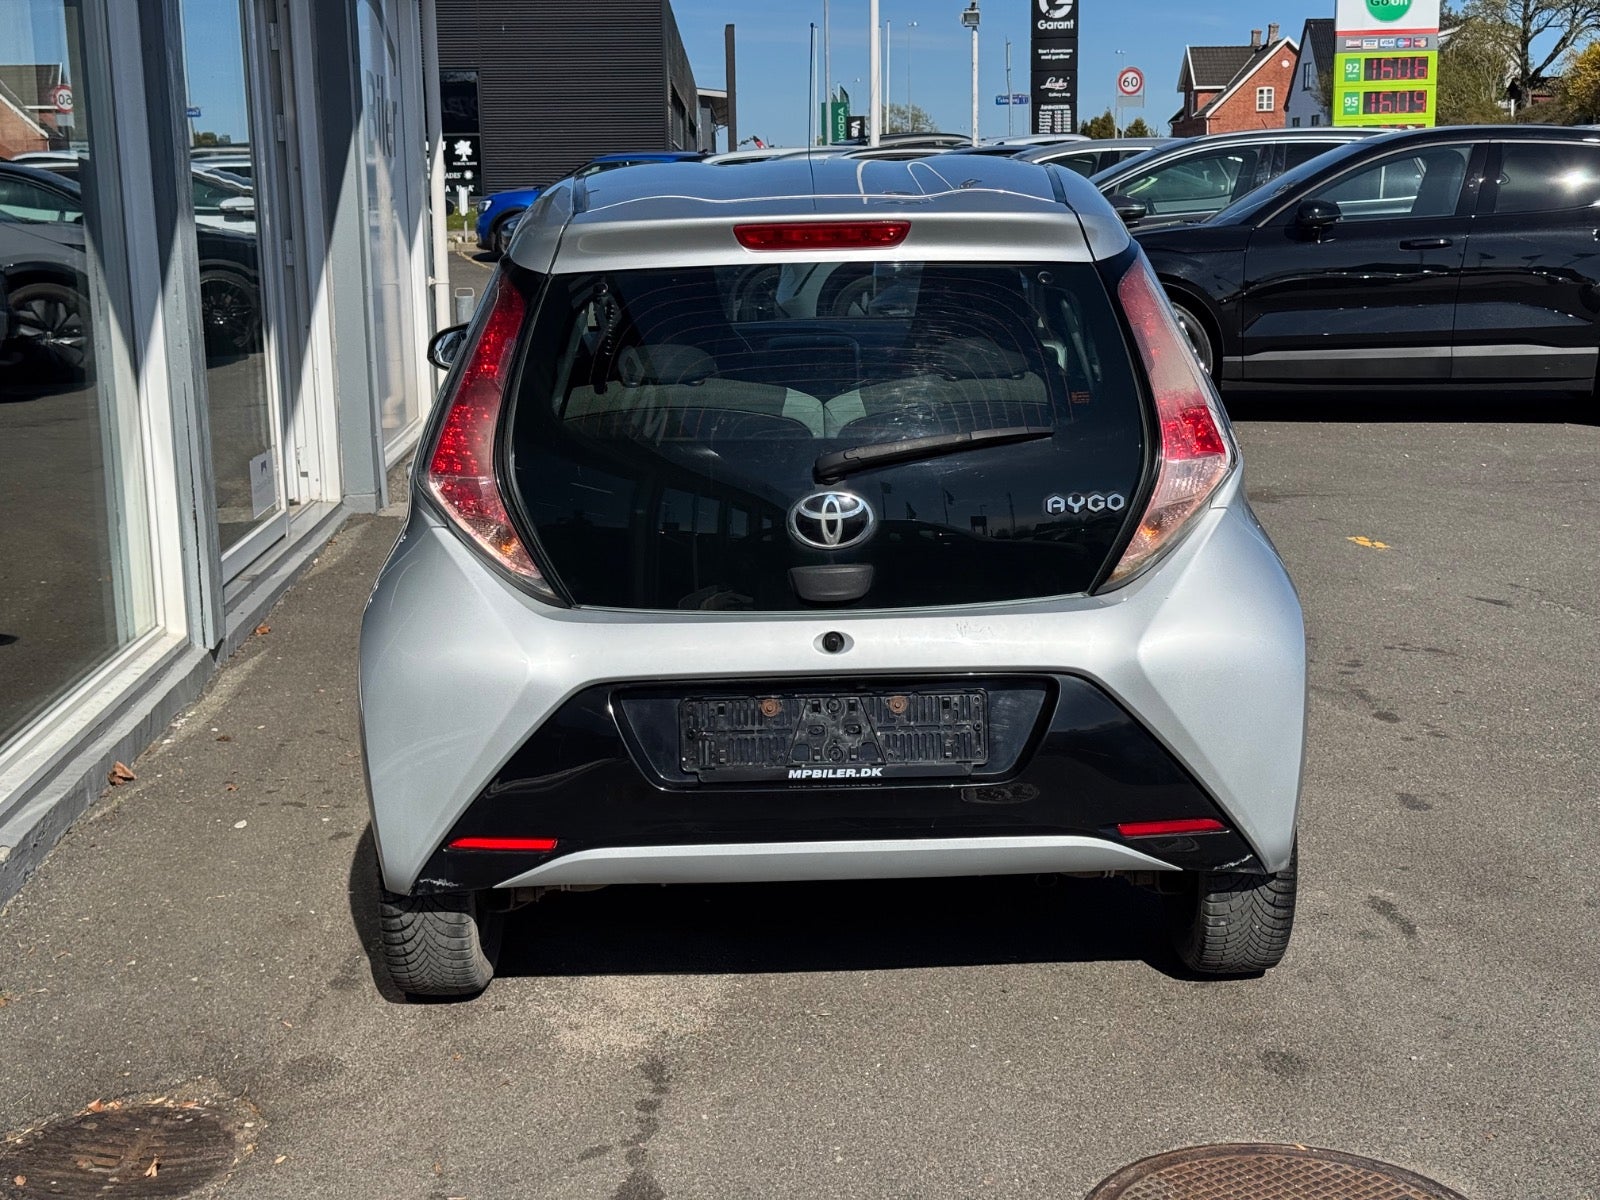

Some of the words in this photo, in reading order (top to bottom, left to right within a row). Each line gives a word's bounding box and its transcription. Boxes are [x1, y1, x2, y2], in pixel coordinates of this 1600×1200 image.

[1037, 19, 1074, 30] Garant
[1346, 63, 1359, 73] 92
[1122, 76, 1139, 88] 60
[1344, 97, 1358, 107] 95
[1046, 493, 1125, 514] AYGO
[788, 768, 884, 779] MPBILER.DK
